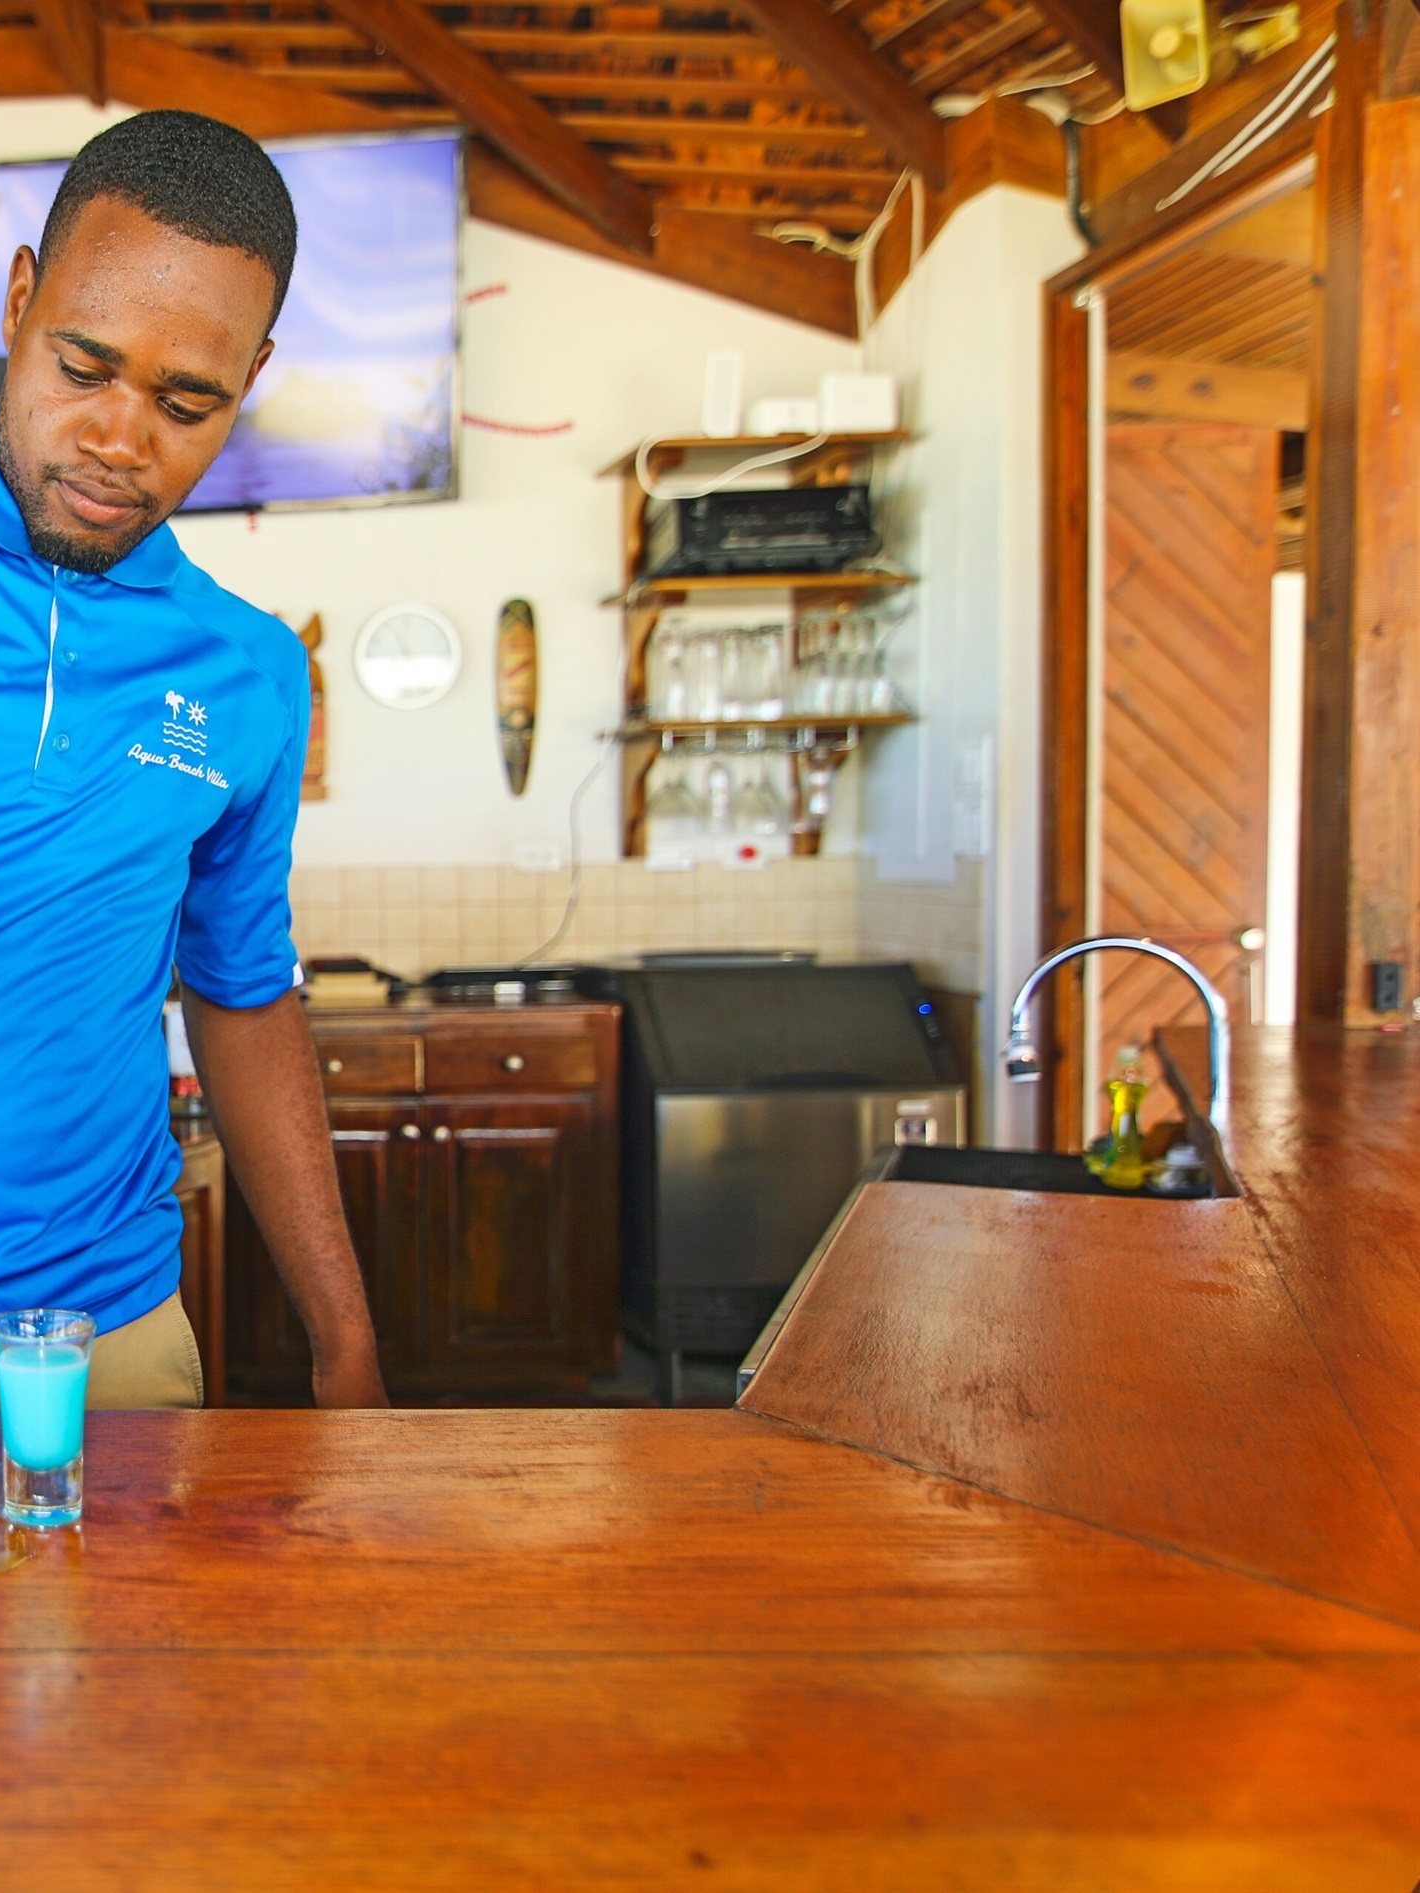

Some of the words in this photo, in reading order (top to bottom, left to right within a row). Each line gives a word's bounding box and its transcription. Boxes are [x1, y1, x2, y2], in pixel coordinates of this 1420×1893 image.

[128, 743, 167, 765] Aqua
[168, 754, 204, 778] Beach
[206, 766, 229, 789] Villa
